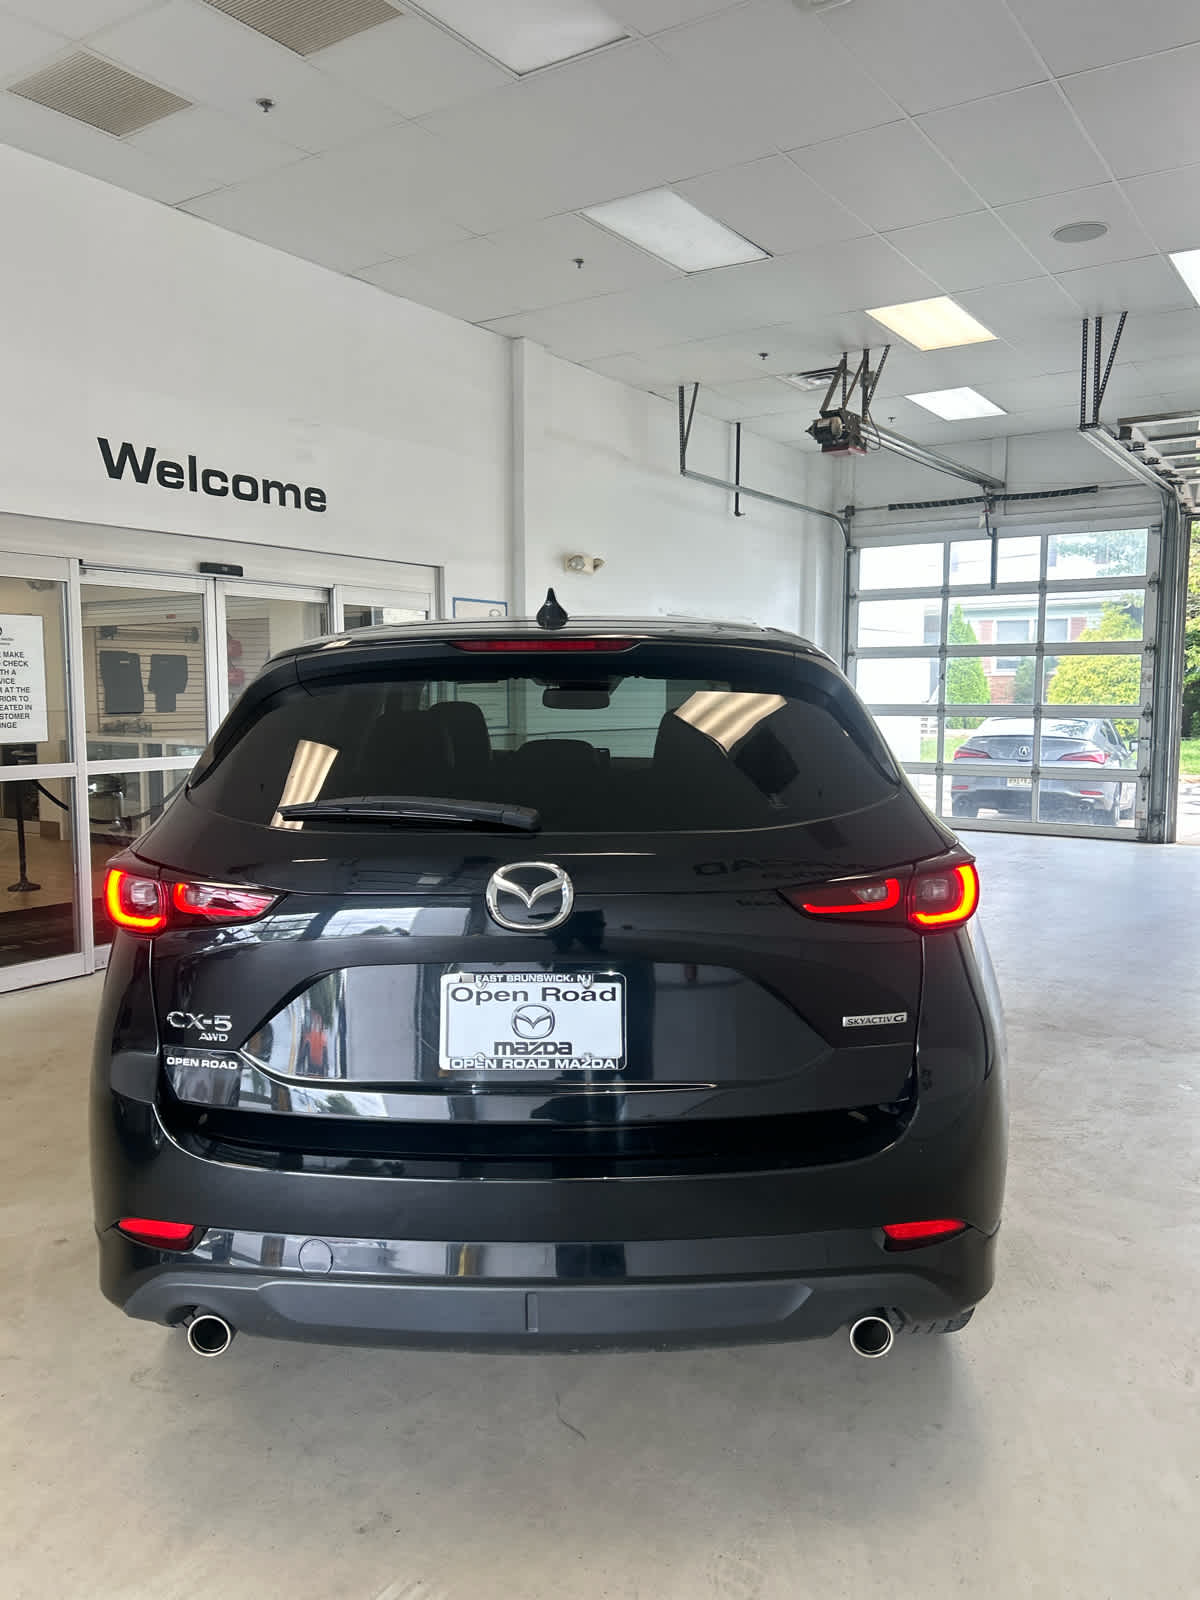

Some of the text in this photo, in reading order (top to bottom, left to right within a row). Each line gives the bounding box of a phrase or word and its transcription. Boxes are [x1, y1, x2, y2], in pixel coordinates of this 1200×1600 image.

[97, 437, 326, 512] Welcome
[475, 974, 503, 983] EAST
[451, 987, 616, 1006] Open Road
[166, 1011, 233, 1032] CX-5
[199, 1032, 229, 1042] AWD
[494, 1041, 573, 1056] mazda
[166, 1056, 238, 1070] OPEN ROAD
[451, 1059, 617, 1070] OPEN ROAD MAZDA
